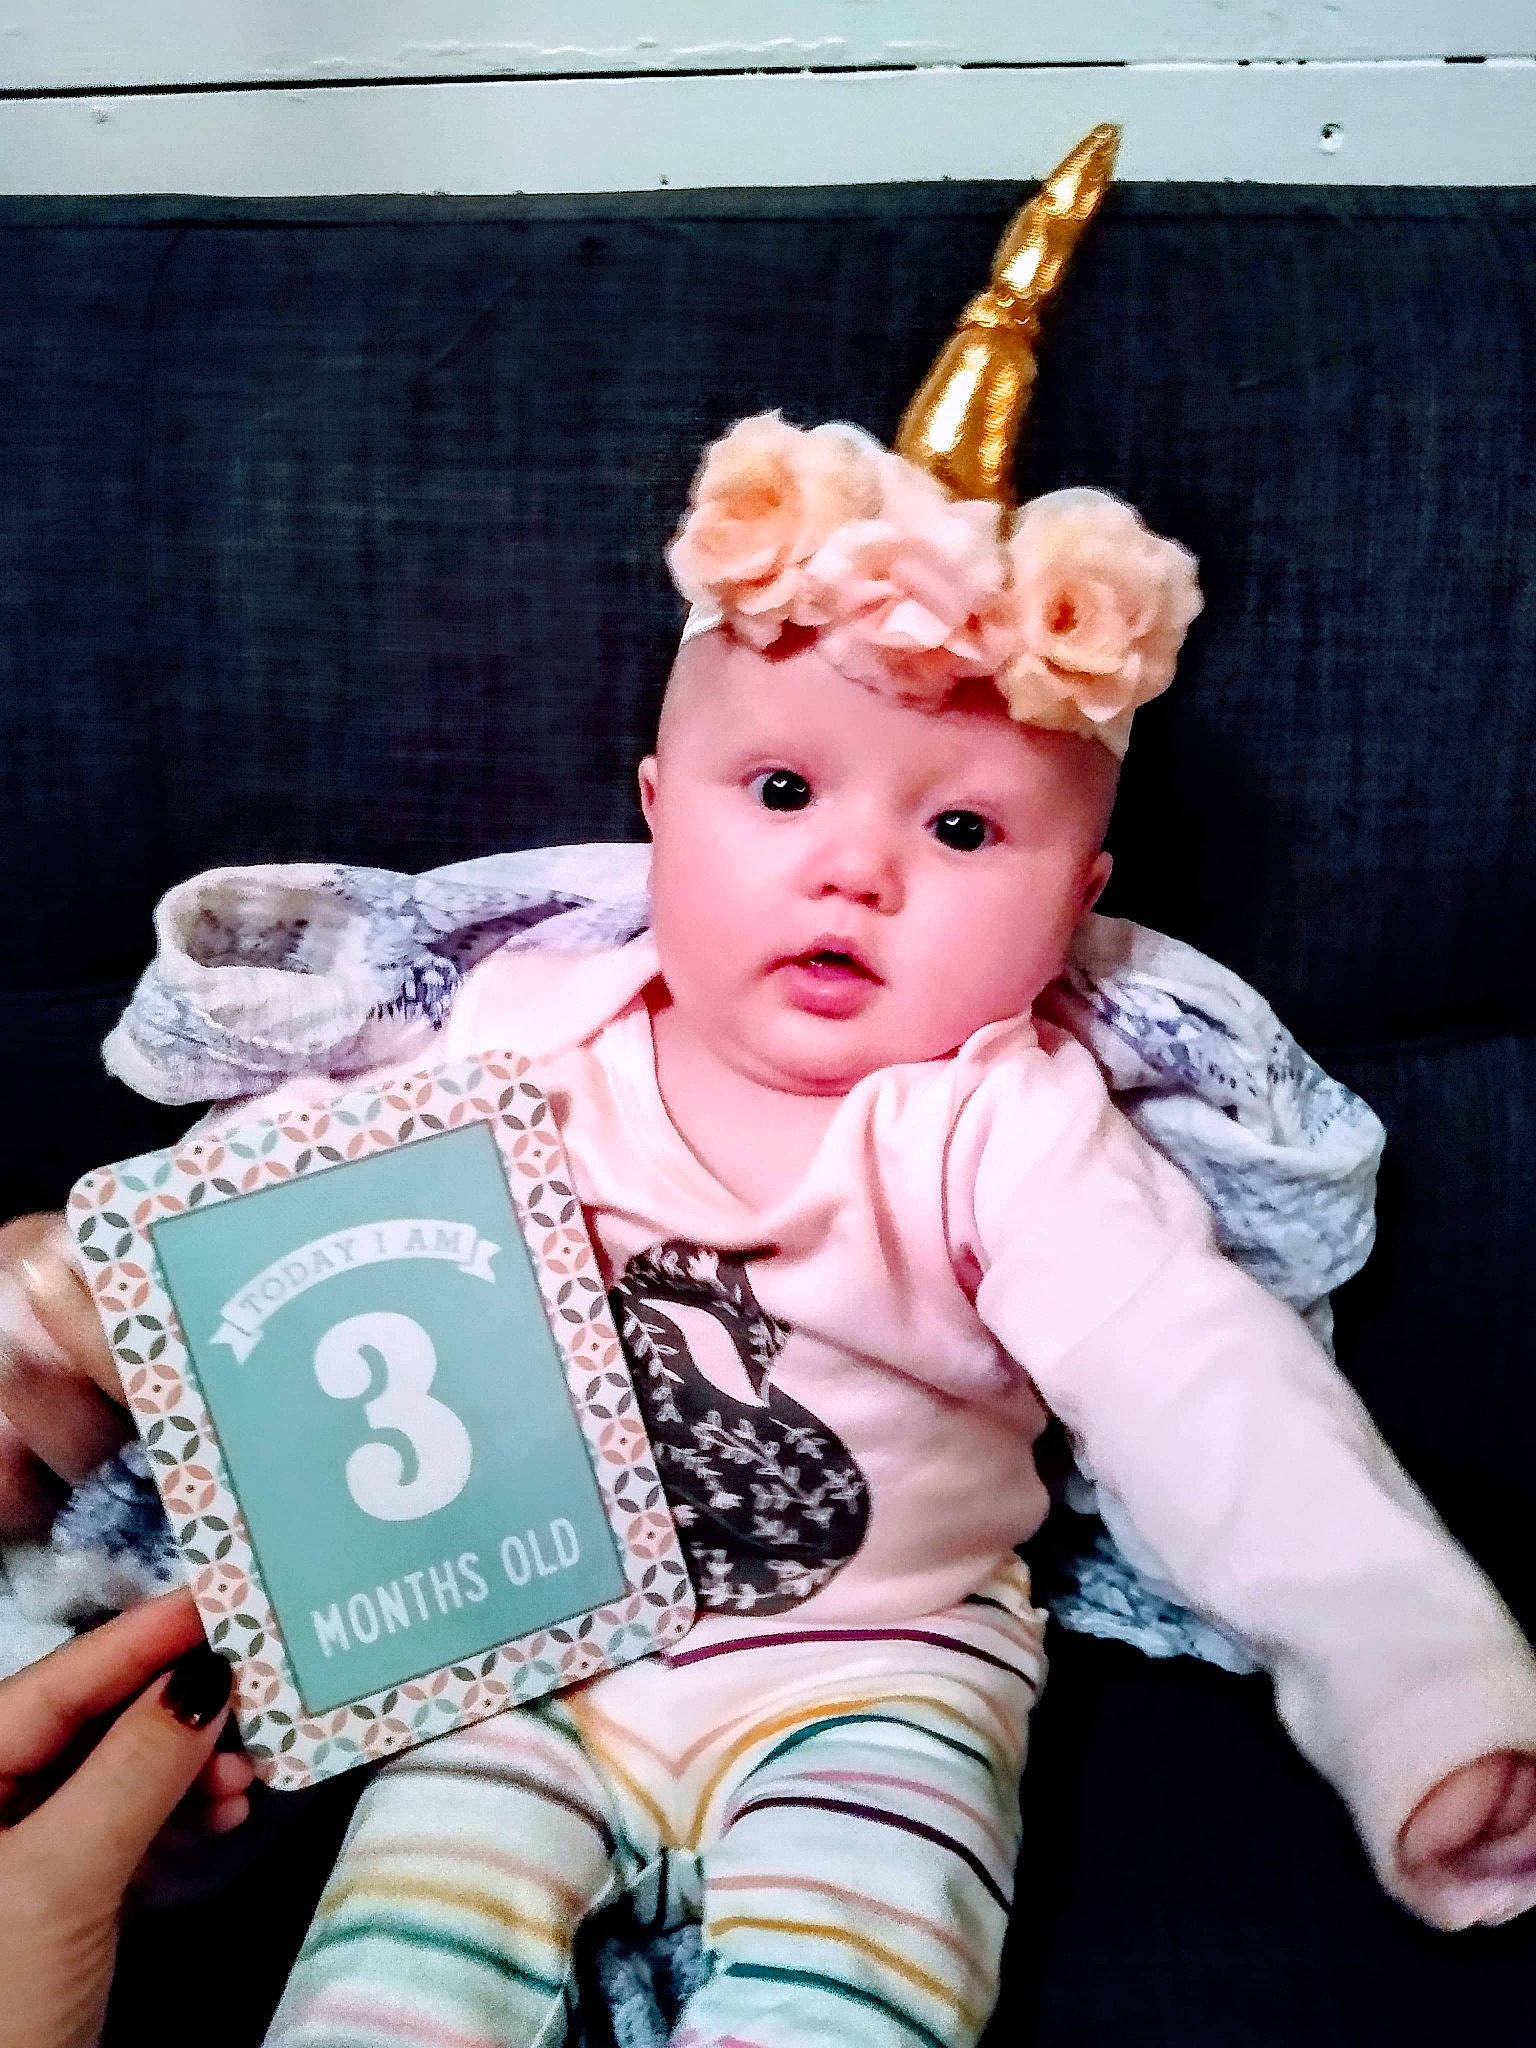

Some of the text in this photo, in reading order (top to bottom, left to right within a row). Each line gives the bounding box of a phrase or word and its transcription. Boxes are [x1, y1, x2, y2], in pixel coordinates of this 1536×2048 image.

[239, 1228, 463, 1316] TODAY I AM
[315, 1312, 472, 1521] 3
[311, 1518, 581, 1657] MONTHS OLD
